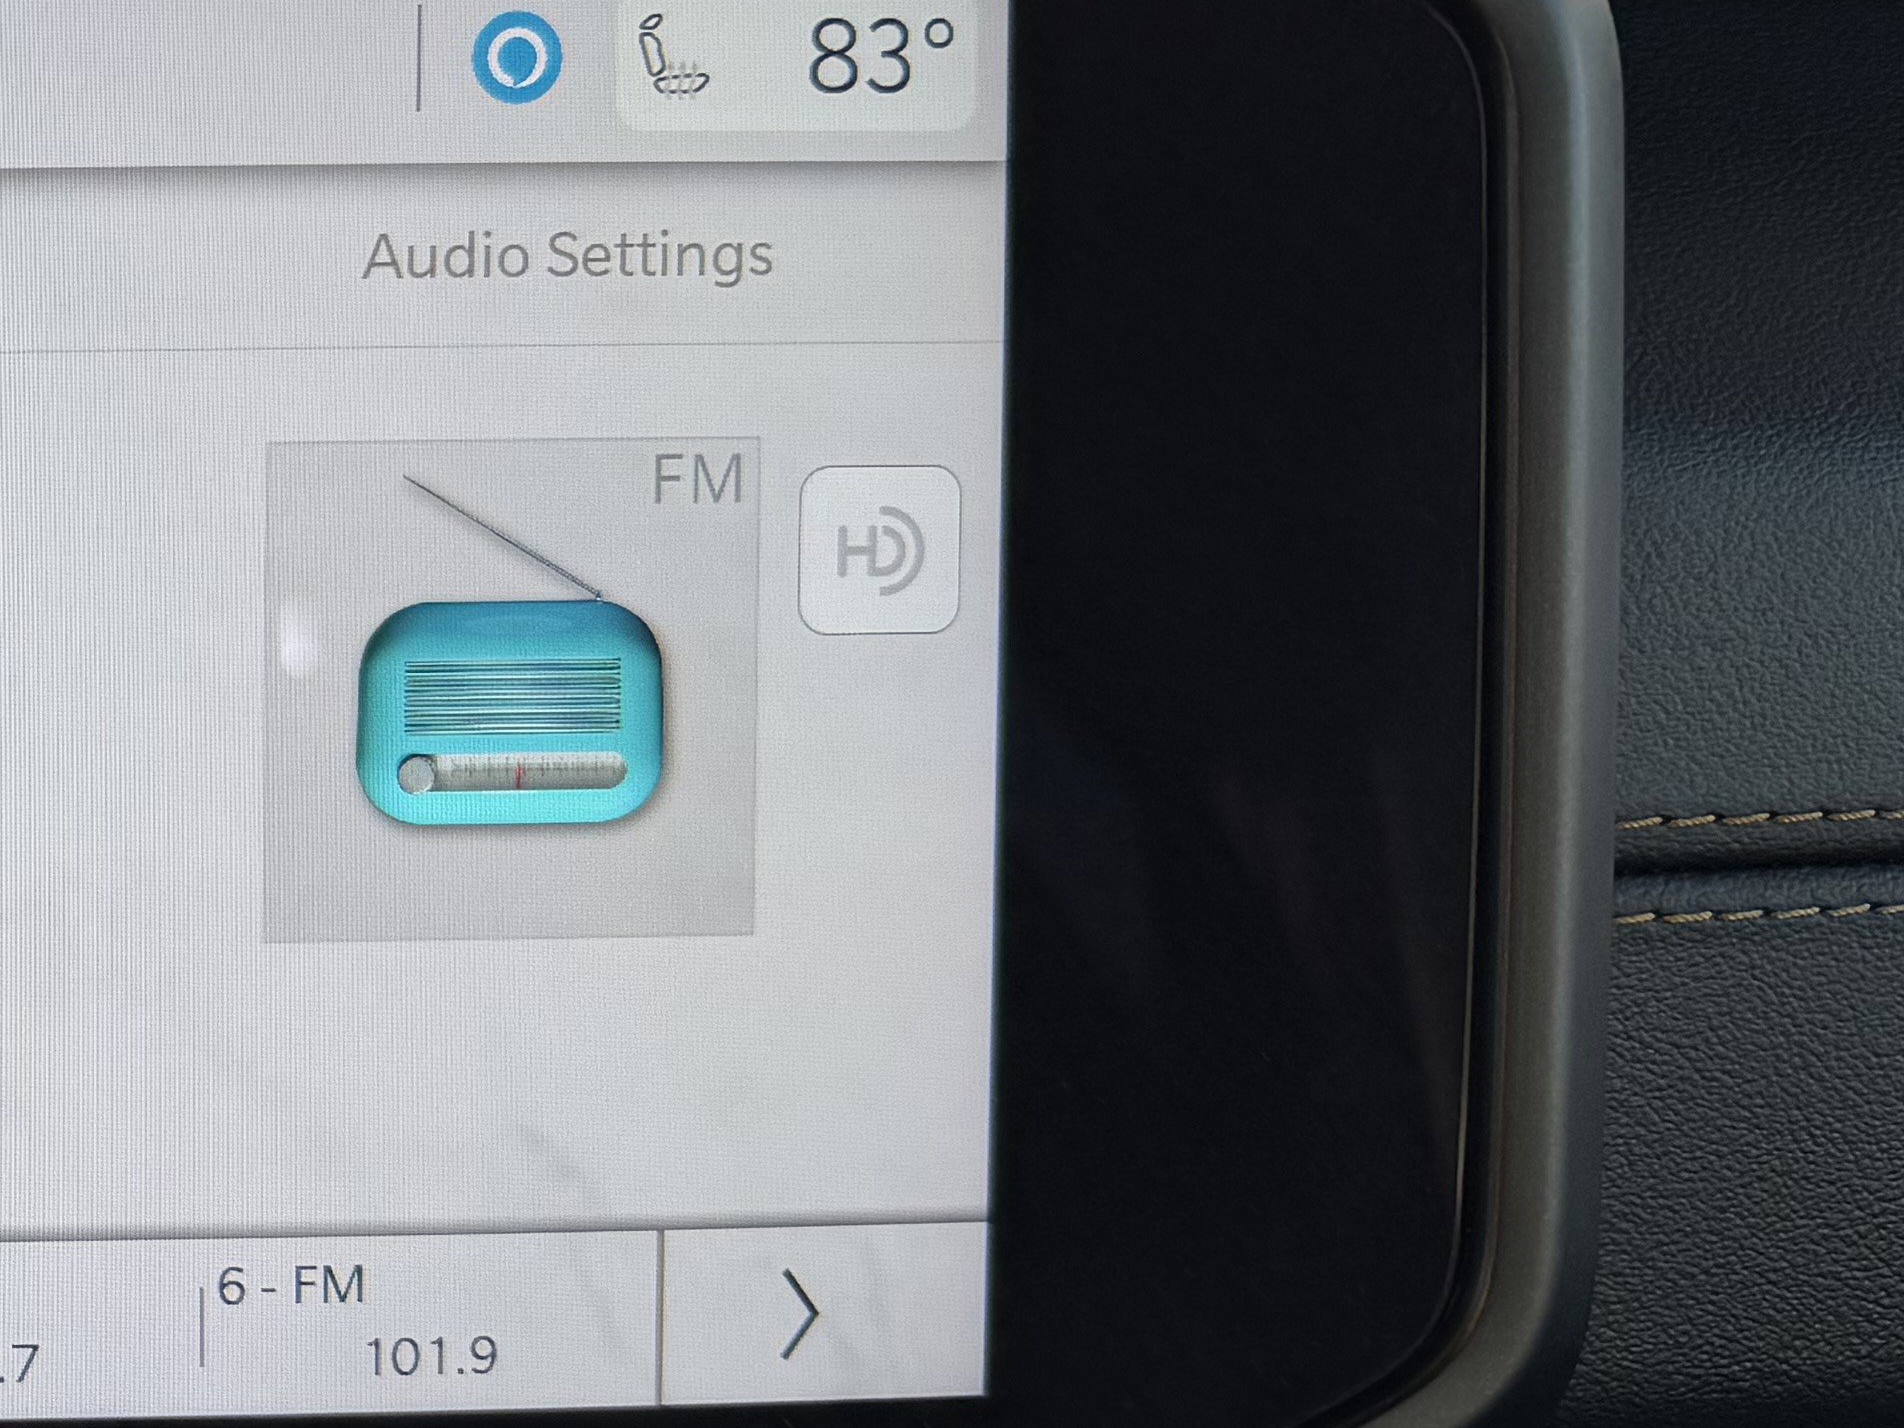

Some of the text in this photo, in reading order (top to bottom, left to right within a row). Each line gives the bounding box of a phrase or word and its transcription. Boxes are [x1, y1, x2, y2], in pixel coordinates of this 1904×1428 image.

[360, 229, 775, 290] Audio Settings
[654, 451, 743, 505] FM
[218, 1267, 245, 1307] 6
[294, 1264, 365, 1304] FM
[367, 1335, 498, 1378] 101.9
